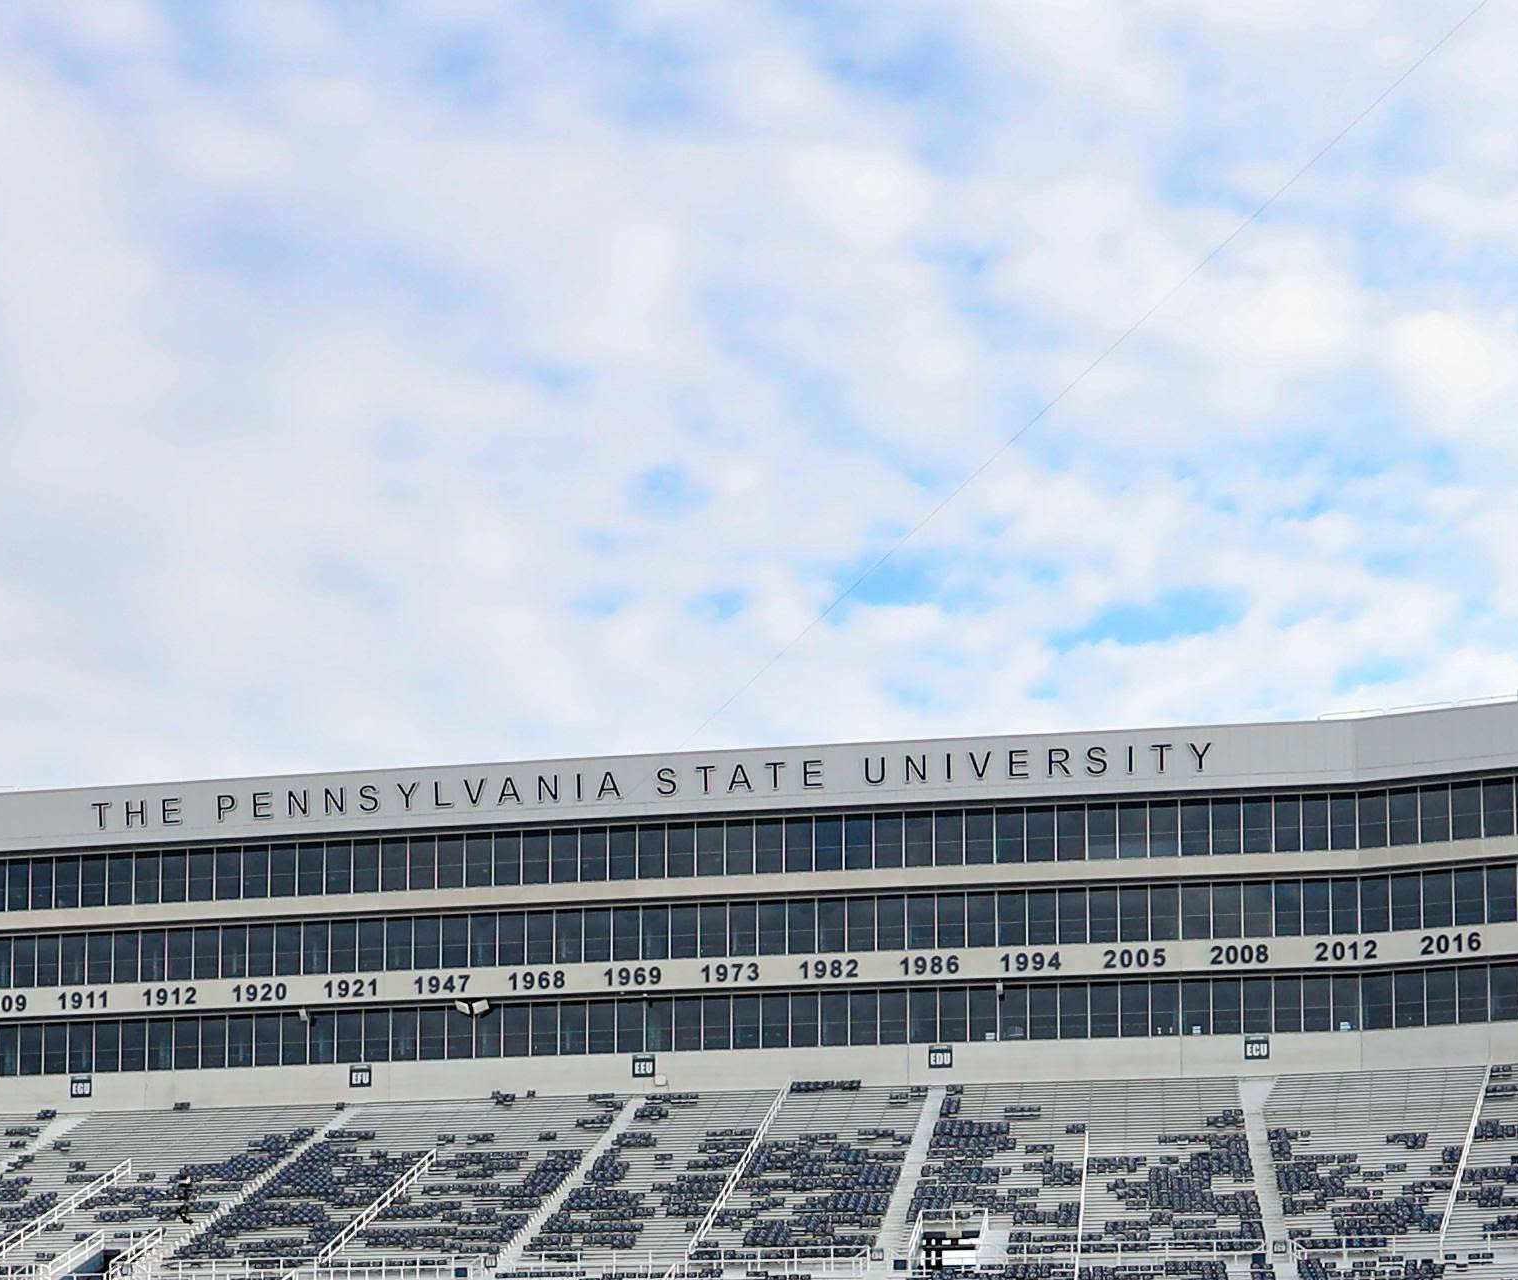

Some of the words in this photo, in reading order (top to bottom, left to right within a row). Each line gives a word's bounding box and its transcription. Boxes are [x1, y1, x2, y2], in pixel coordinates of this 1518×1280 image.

[91, 798, 182, 828] THE
[216, 771, 622, 822] PENNSYLVANIA
[657, 759, 824, 795] STATE
[863, 742, 1213, 785] UNIVERSITY
[58, 990, 109, 1010] 1911
[142, 986, 197, 1007] 1912
[232, 983, 287, 1003] 1920
[323, 978, 378, 999] 1921
[414, 975, 471, 995] 1947
[508, 970, 566, 991] 1968
[603, 966, 662, 987] 1969
[701, 962, 760, 983] 1973
[799, 959, 859, 980] 1982
[900, 954, 960, 976] 1986
[1000, 951, 1062, 972] 1994
[1103, 948, 1167, 969] 2005
[1210, 944, 1269, 965] 2008
[1315, 940, 1378, 962] 2012
[1420, 932, 1482, 955] 2016
[1246, 1044, 1268, 1057] ECU
[930, 1053, 951, 1065] EDU
[634, 1062, 653, 1074] EEU
[351, 1072, 370, 1084] EFU
[71, 1082, 91, 1095] EGU
